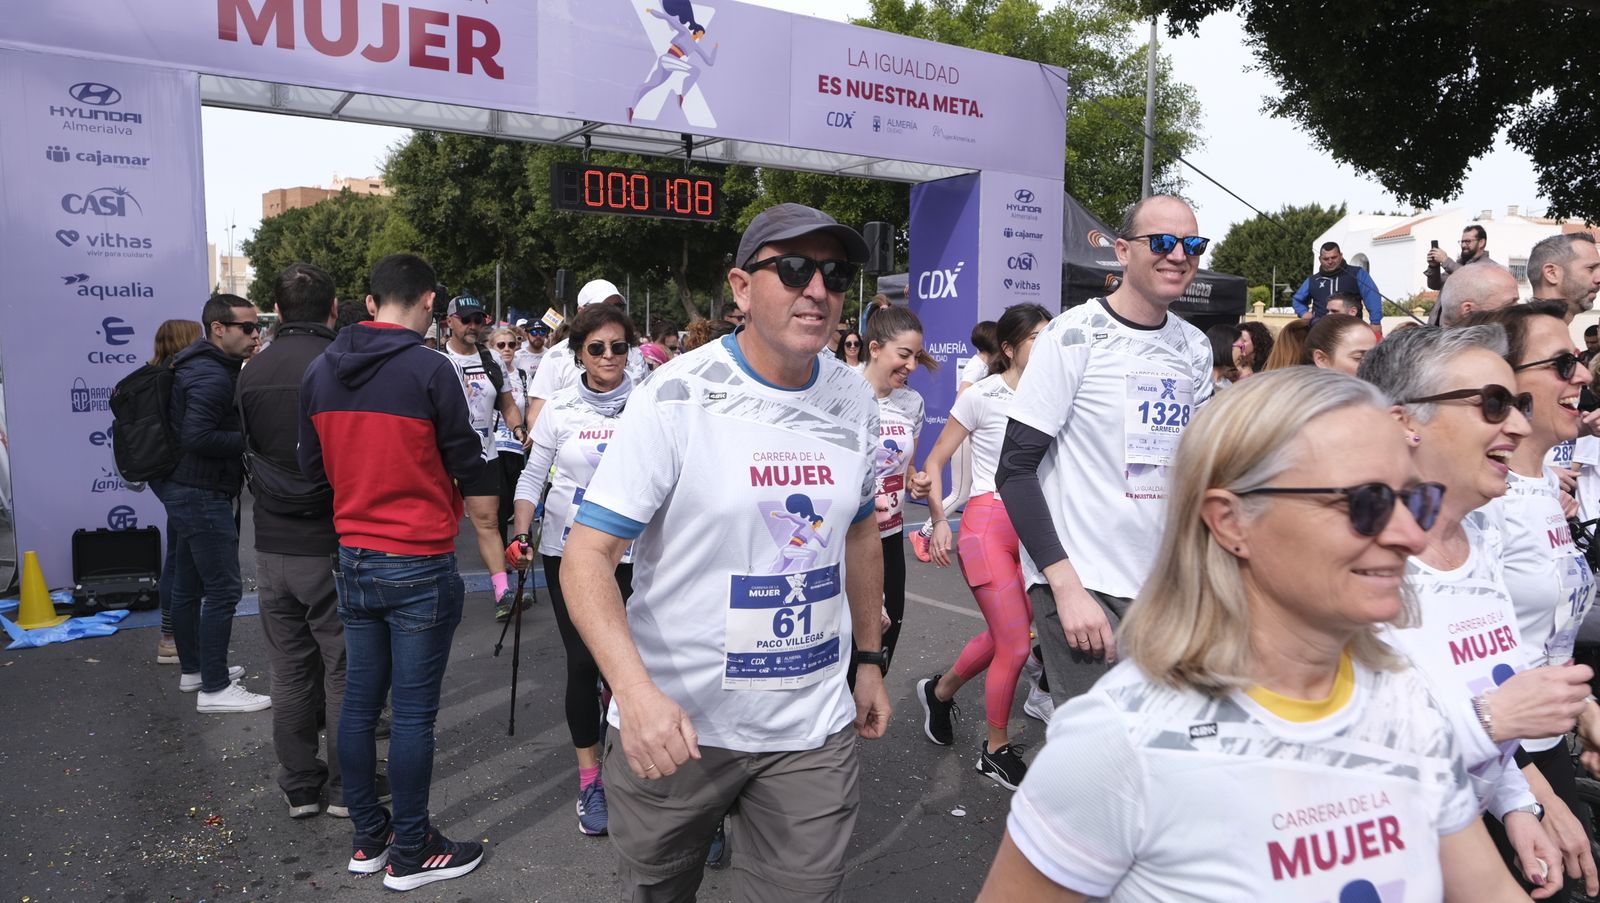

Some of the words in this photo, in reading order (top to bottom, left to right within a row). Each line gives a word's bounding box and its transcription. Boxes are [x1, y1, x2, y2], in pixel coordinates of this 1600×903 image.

[217, 0, 505, 80] MUJER
[848, 47, 869, 69] LA
[875, 53, 960, 85] IGUALDAD
[818, 74, 842, 95] ES
[847, 79, 930, 110] NUESTRA
[933, 94, 984, 119] META.
[50, 105, 142, 124] HYUNDAI
[826, 110, 856, 129] CDX
[62, 120, 133, 136] Almerialva
[76, 150, 150, 167] cajamar
[61, 192, 126, 217] CASI
[1006, 203, 1042, 214] HYUNDAI
[86, 232, 152, 249] vithas
[1015, 229, 1043, 240] cajamar
[1007, 256, 1033, 271] CASI
[918, 261, 964, 299] CDX
[1015, 280, 1041, 291] vithas
[77, 282, 154, 301] aqualia
[929, 341, 968, 354] ALMERÍA
[88, 351, 137, 364] Clece
[91, 387, 112, 399] ARRO
[1138, 400, 1190, 428] 1328
[1150, 425, 1180, 434] CARMELO
[753, 451, 797, 462] CARRERA
[799, 451, 812, 461] DE
[814, 451, 825, 461] LA
[749, 465, 835, 487] MUJER
[91, 478, 125, 493] Lanj
[749, 589, 781, 597] MUJER
[772, 604, 812, 638] 61
[756, 639, 783, 648] PACO
[785, 631, 825, 647] VILLEGAS
[1448, 624, 1518, 666] MUJER
[1272, 801, 1347, 831] CARRERA
[1348, 795, 1369, 815] DE
[1371, 791, 1391, 809] LA
[1267, 814, 1406, 881] MUJER
